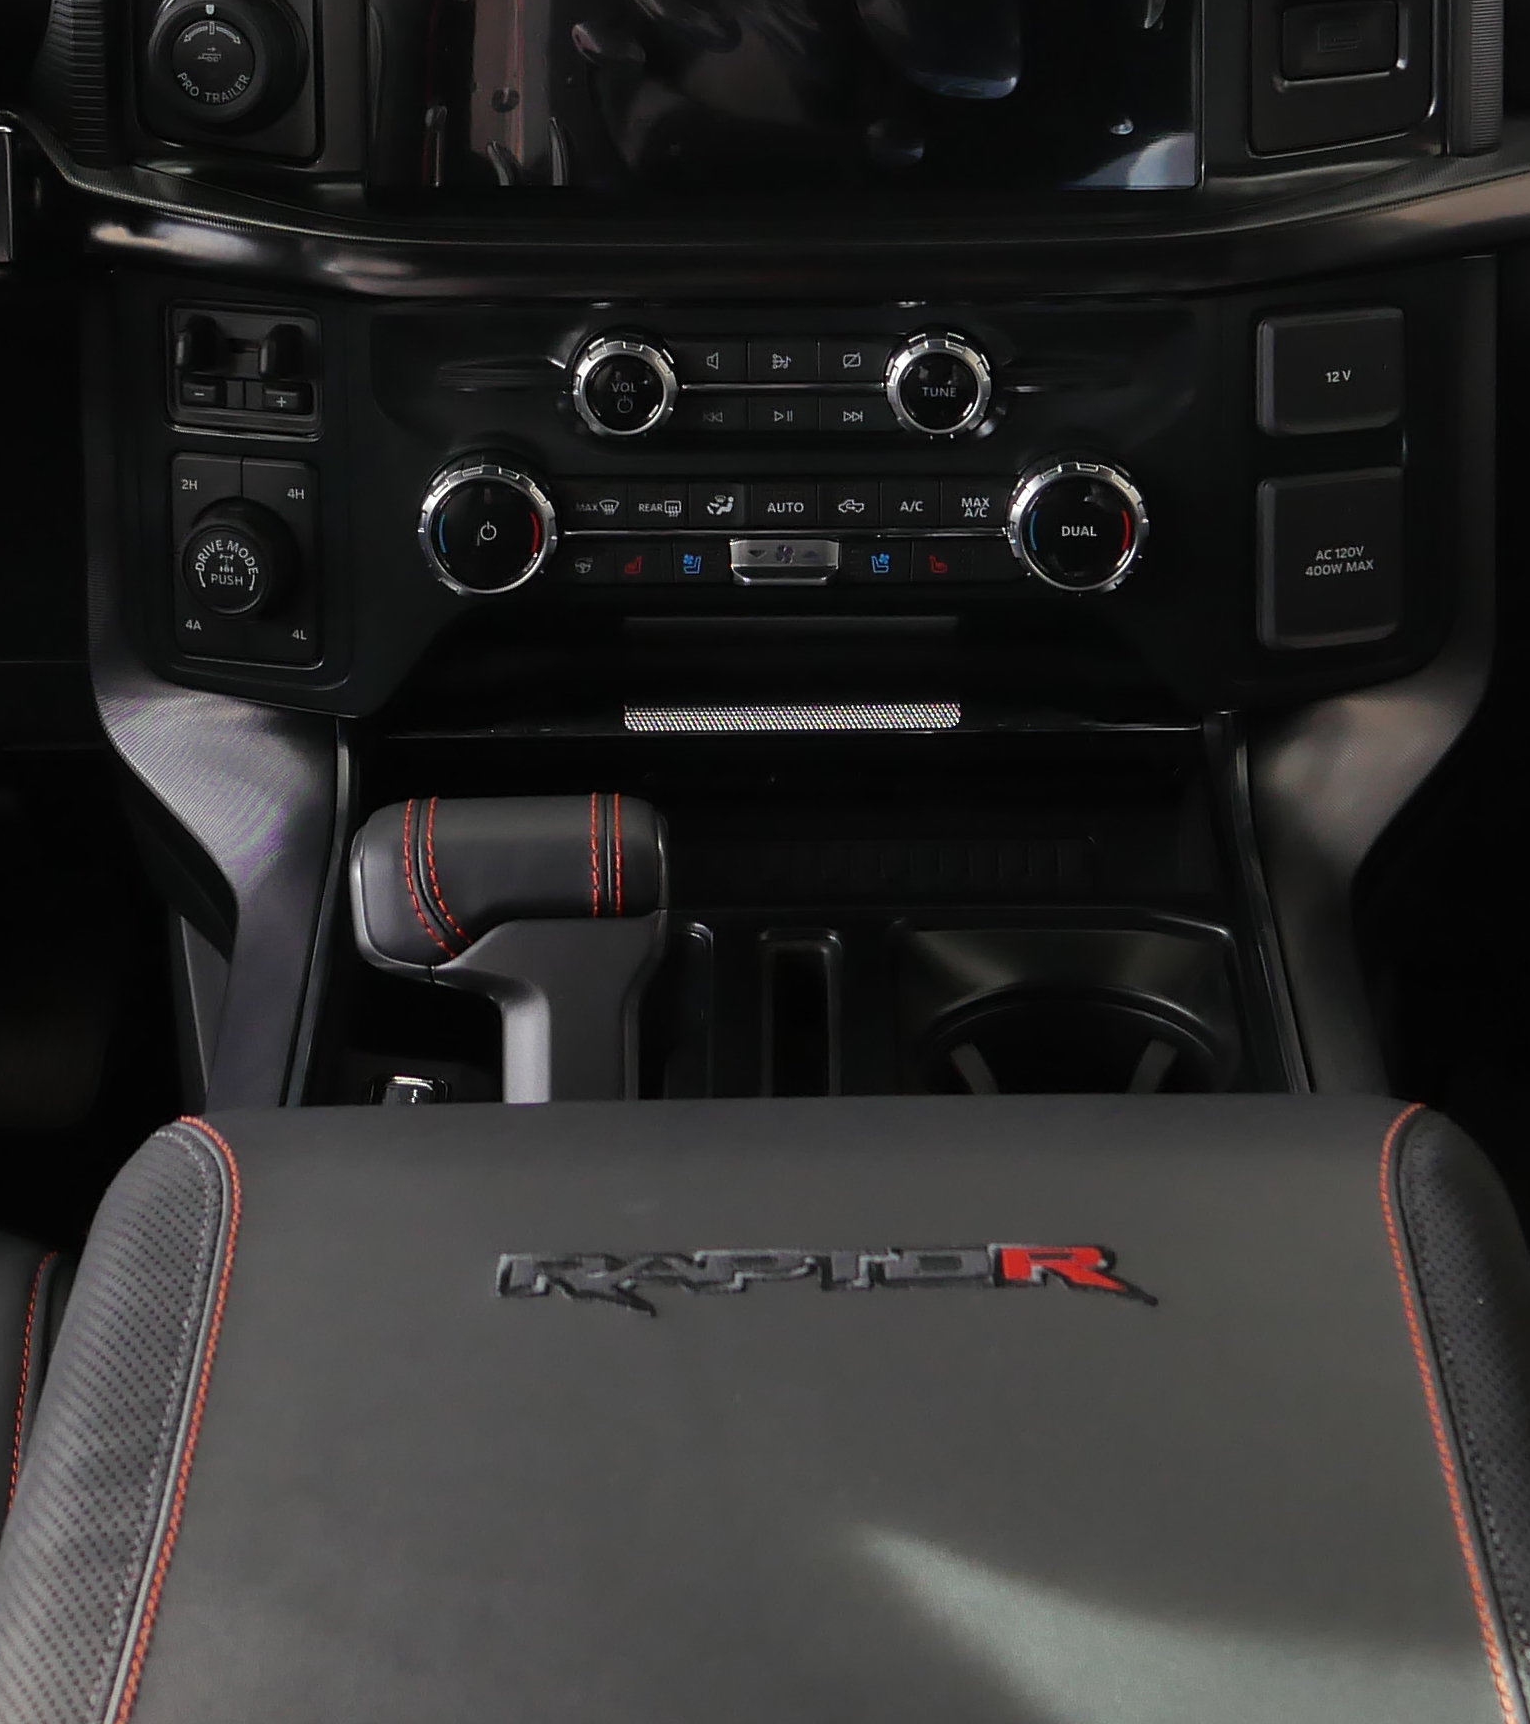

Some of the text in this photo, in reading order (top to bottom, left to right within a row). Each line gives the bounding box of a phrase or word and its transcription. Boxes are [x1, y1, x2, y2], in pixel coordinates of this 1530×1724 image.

[177, 71, 251, 105] PRO TRAILER
[1325, 369, 1352, 384] 12 V
[610, 381, 637, 394] VOL
[921, 386, 957, 398] TUNE
[181, 478, 198, 491] 2H
[287, 488, 305, 500] 4H
[576, 503, 599, 512] MAX
[638, 502, 664, 512] REAR
[767, 502, 805, 514] AUTO
[900, 500, 925, 513] A/C
[961, 497, 990, 509] MAX
[964, 508, 988, 519] A/C
[1061, 525, 1098, 538] DUAL
[194, 539, 260, 577] DRIVE MODE
[1315, 546, 1365, 561] AC 120V
[1305, 560, 1374, 577] 400W MAX
[210, 573, 244, 587] PUSH
[185, 618, 202, 632] 4A
[292, 629, 307, 641] 4L
[496, 1243, 1159, 1318] RAPTOR
